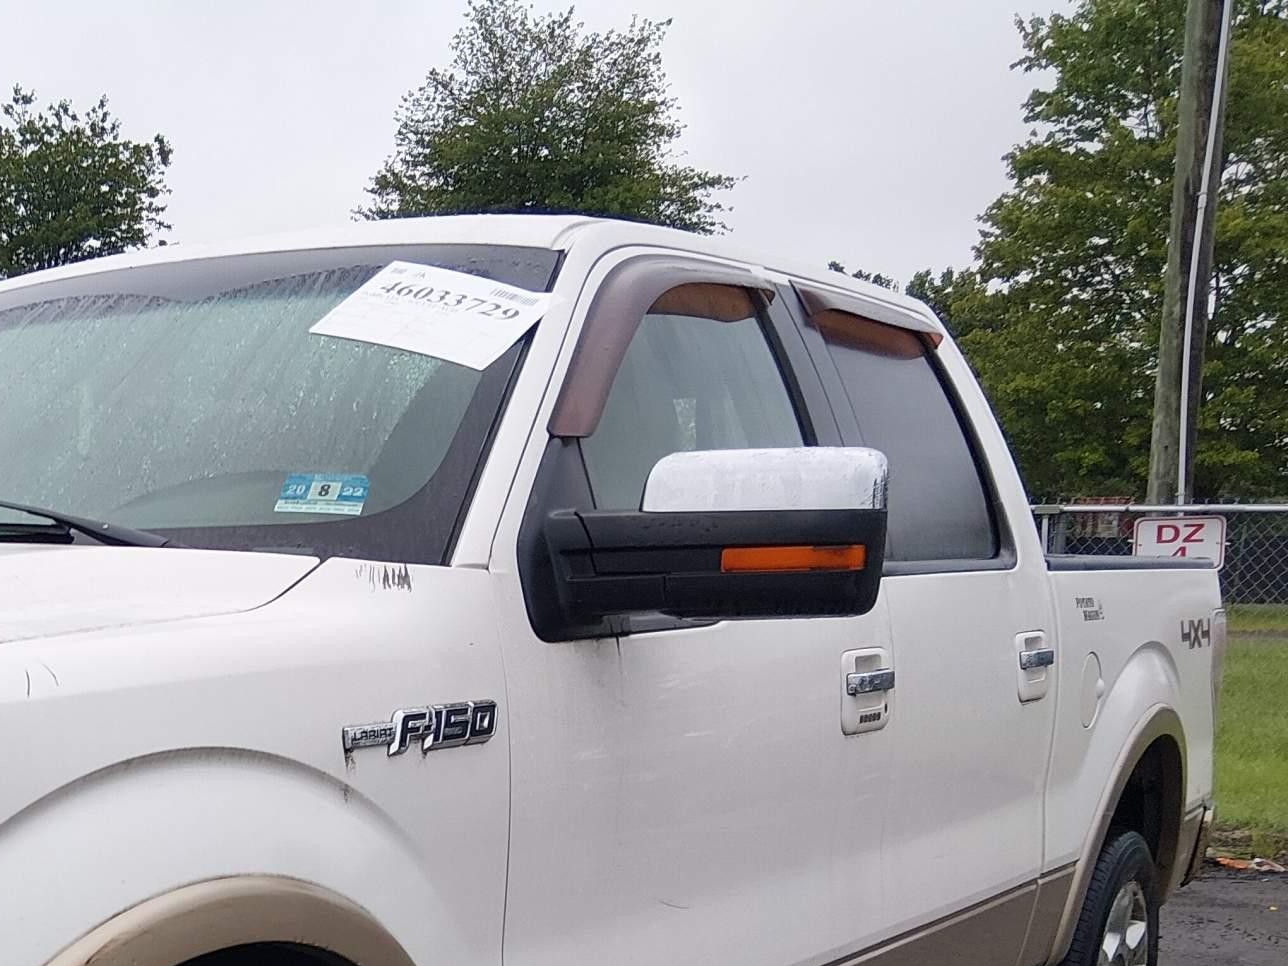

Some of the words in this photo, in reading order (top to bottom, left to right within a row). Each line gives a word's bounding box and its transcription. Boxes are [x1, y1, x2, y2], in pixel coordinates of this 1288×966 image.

[380, 281, 521, 321] 46033729
[286, 483, 306, 496] 20
[318, 483, 331, 497] 8
[341, 486, 364, 497] 22
[1156, 523, 1205, 544] DZ
[352, 726, 394, 743] LARIAT
